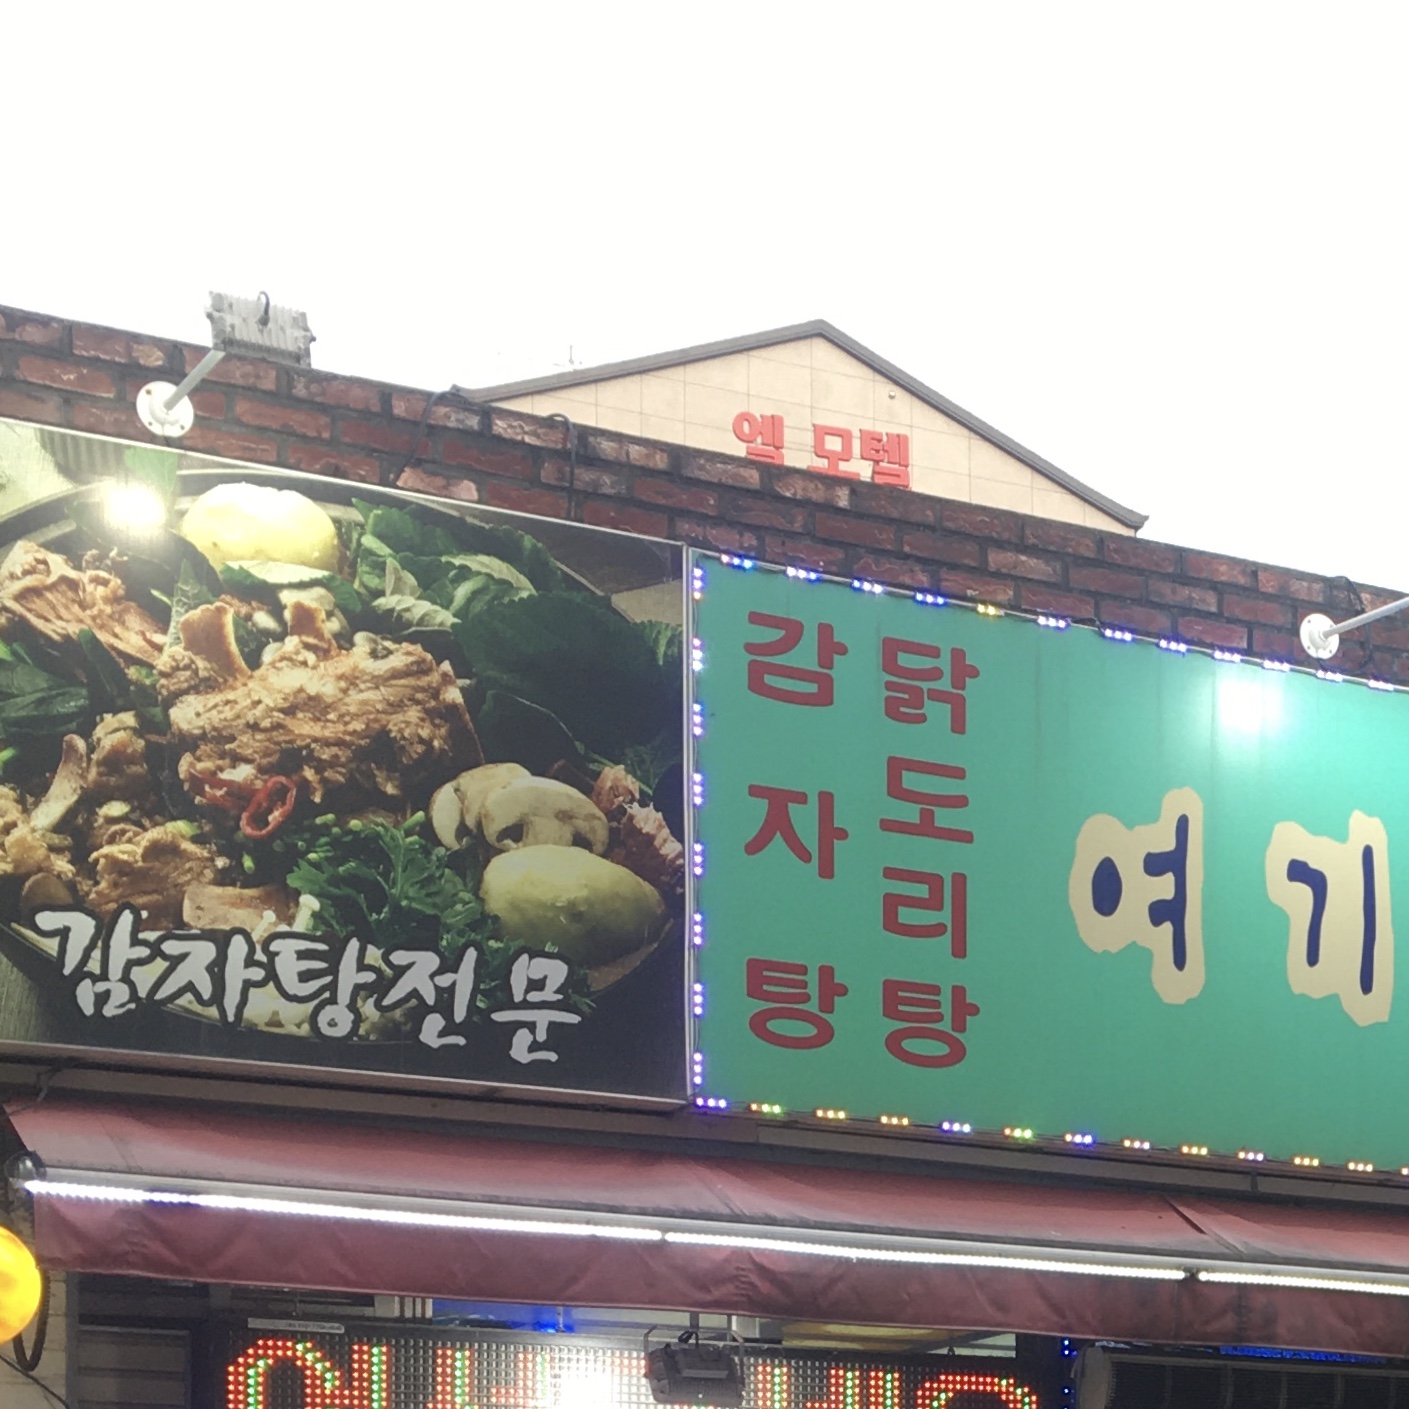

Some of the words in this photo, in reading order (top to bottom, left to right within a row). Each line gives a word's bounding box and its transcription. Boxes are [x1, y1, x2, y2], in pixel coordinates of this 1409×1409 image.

[732, 411, 784, 466] 엘
[807, 423, 912, 489] 모텔
[743, 610, 849, 1051] 감자탕
[878, 636, 980, 1068] 닭도리탕
